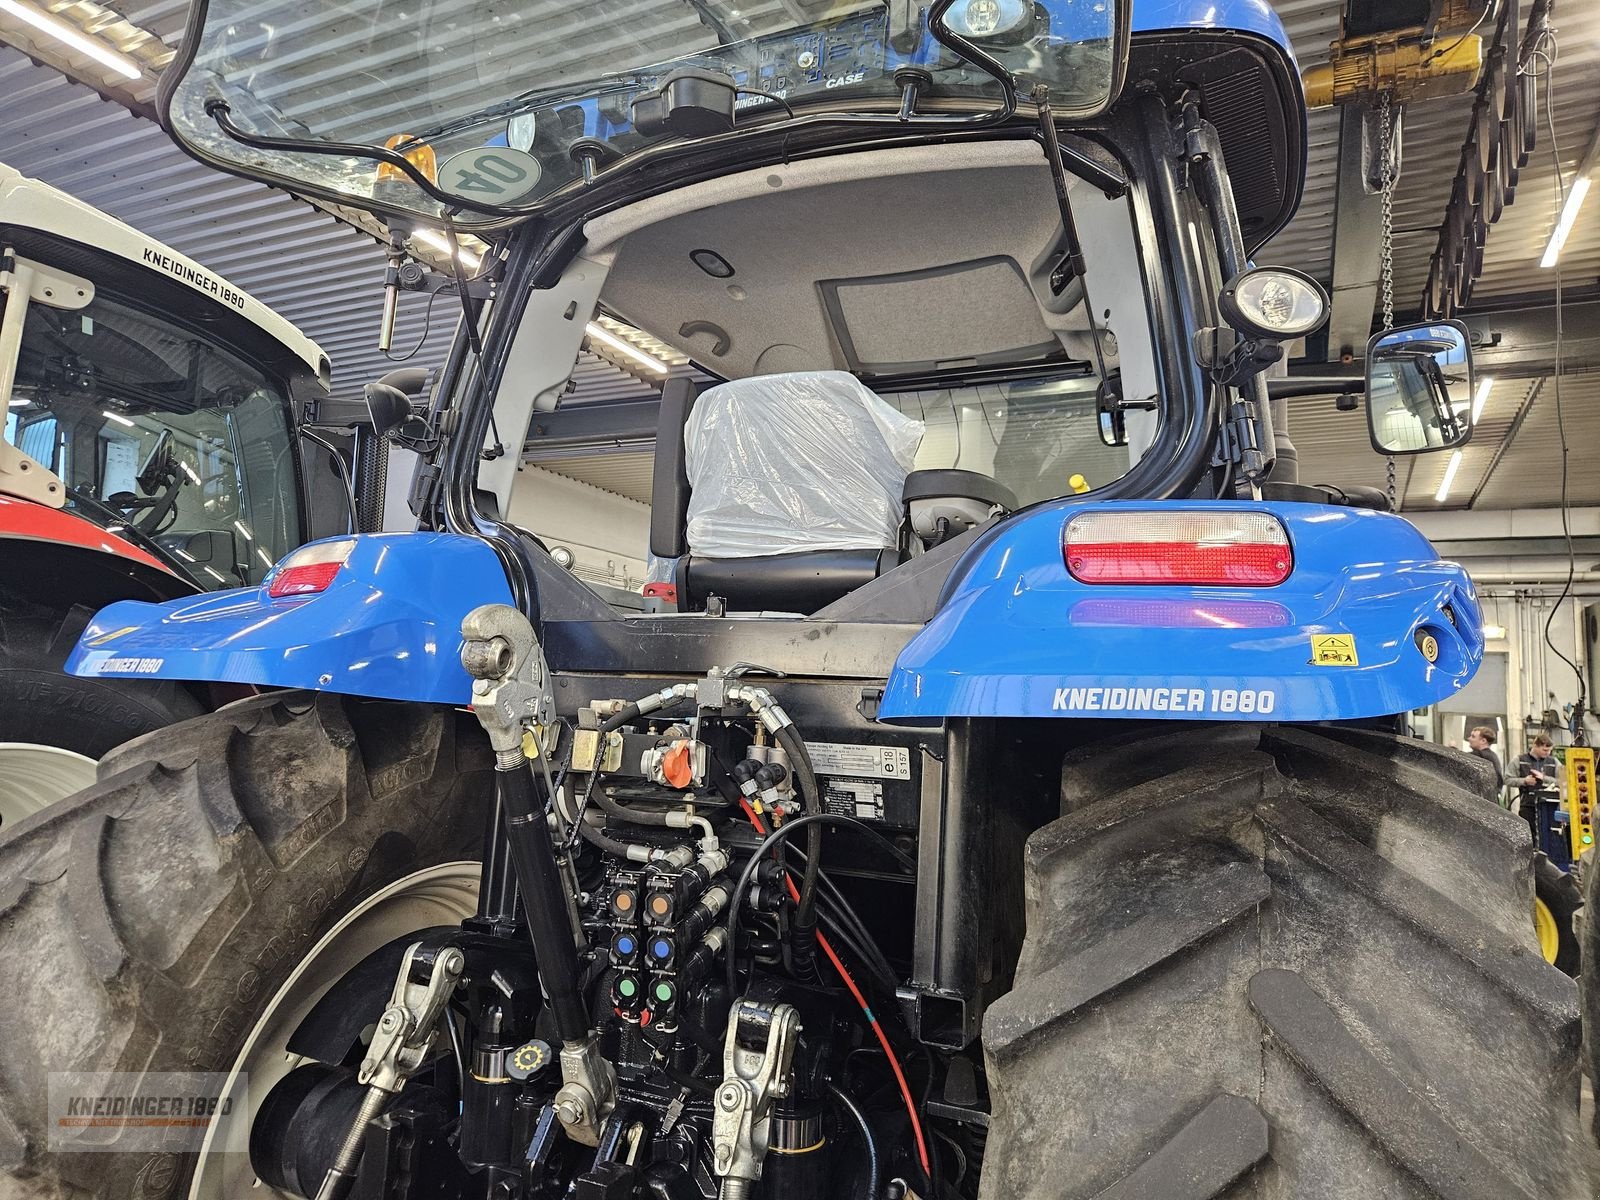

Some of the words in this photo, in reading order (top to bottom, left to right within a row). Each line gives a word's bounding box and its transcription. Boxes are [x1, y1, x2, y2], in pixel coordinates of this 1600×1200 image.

[825, 72, 864, 89] CASE
[735, 95, 765, 110] DINGER
[143, 247, 218, 295] KNEIDINGER
[220, 285, 245, 309] 1880
[136, 658, 164, 674] 1880
[1052, 687, 1205, 712] KNEIDINGER
[1211, 689, 1275, 714] 1880
[884, 751, 893, 761] 18
[884, 763, 894, 772] e
